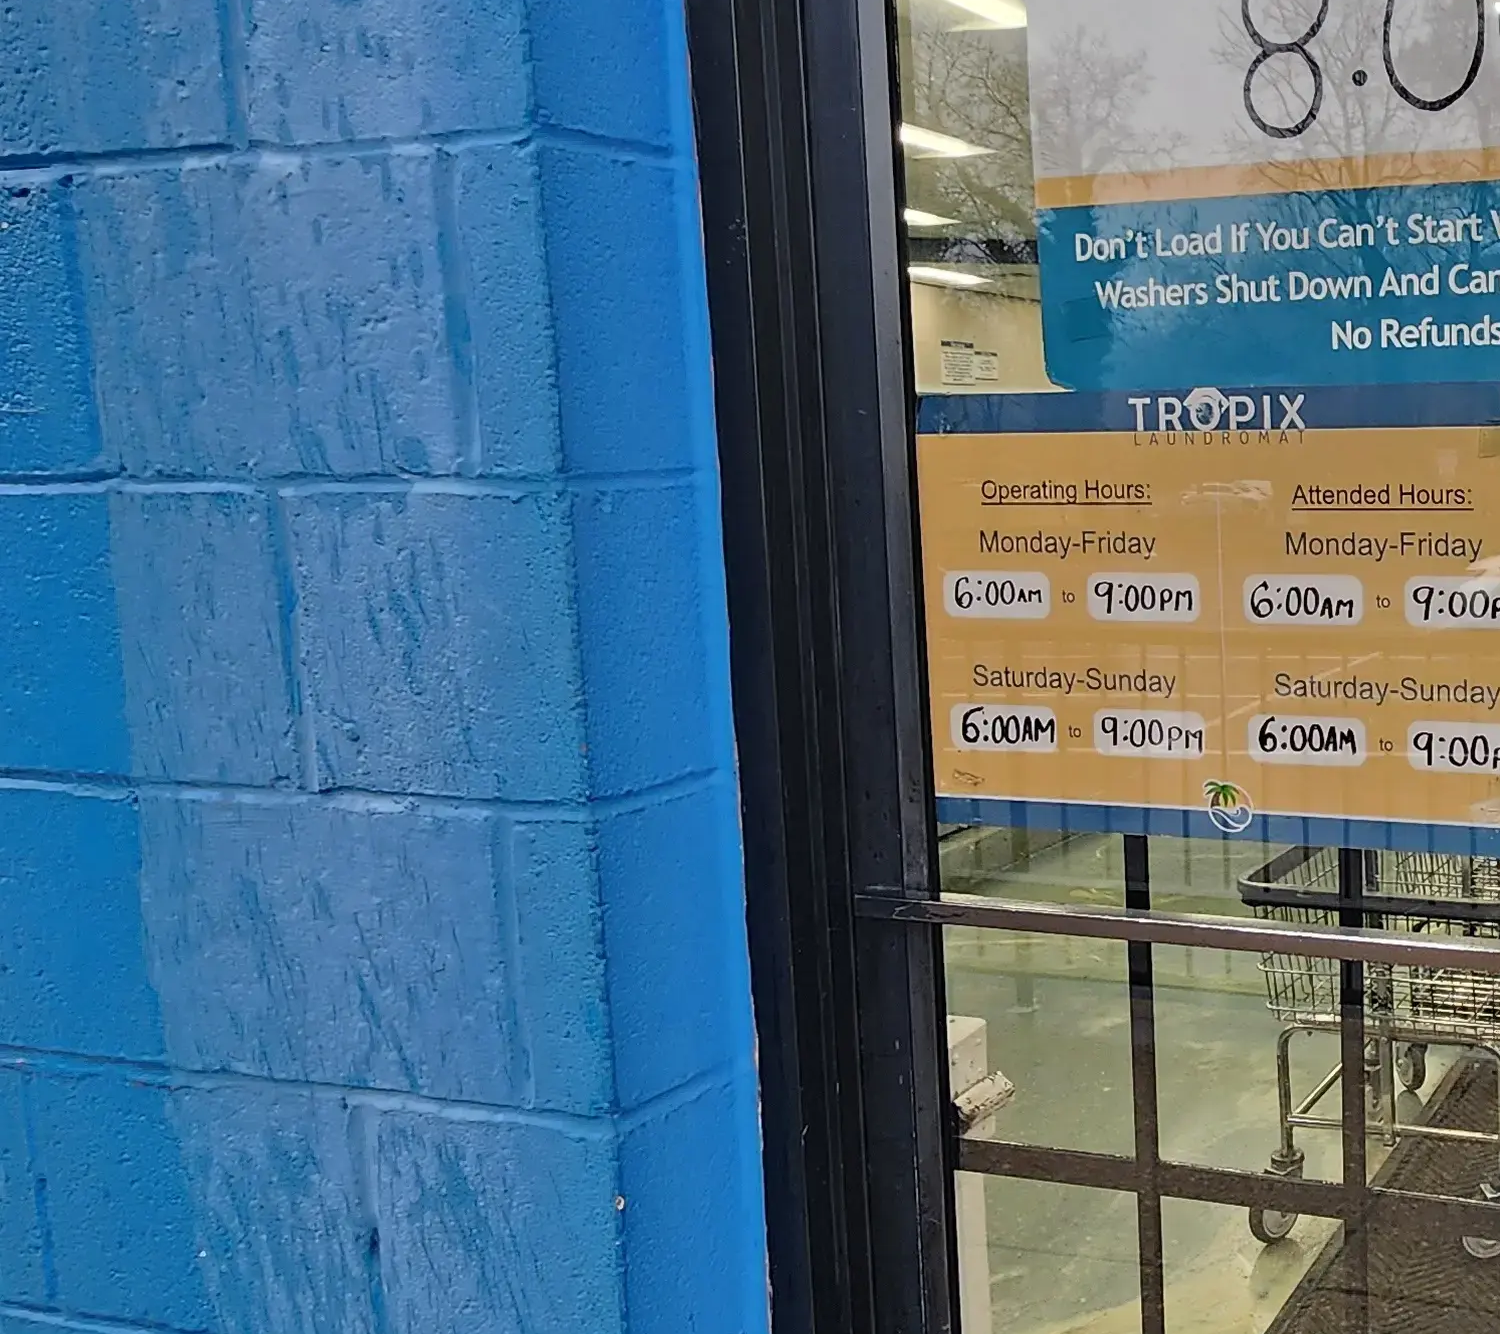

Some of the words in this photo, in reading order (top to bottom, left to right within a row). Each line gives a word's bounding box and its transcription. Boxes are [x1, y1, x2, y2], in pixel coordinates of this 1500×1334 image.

[1074, 229, 1149, 262] Don't
[1155, 223, 1223, 257] Load
[1230, 222, 1250, 253] If
[1255, 221, 1310, 252] You
[1317, 216, 1400, 248] Can't
[1407, 212, 1483, 245] Start
[1094, 278, 1208, 309] Washers
[1215, 272, 1282, 304] Shut
[1288, 270, 1373, 301] Down
[1378, 264, 1440, 298] And
[1331, 320, 1373, 350] No
[1127, 394, 1306, 431] TROPIX
[1133, 430, 1305, 446] LAUNDROMAT
[981, 479, 1078, 504] Operating
[1085, 479, 1151, 500] Hours:
[1292, 483, 1390, 505] Attended
[1399, 483, 1473, 505] Hours:
[979, 529, 1156, 560] Monday-Friday
[1285, 531, 1483, 563] Monday-Friday
[954, 576, 1043, 609] 6:00AM
[1062, 589, 1076, 603] to
[1094, 581, 1194, 614] 9:00PM
[1250, 580, 1354, 619] 6:00AM
[1376, 594, 1391, 609] to
[973, 664, 1176, 698] Saturday-Sunday
[1274, 673, 1500, 710] Saturday-Sunday
[961, 706, 1055, 743] 6:00AM
[1068, 724, 1082, 738] to
[1101, 716, 1203, 753] 9:00PM
[1258, 716, 1357, 755] 6:00AM
[1379, 737, 1394, 752] to
